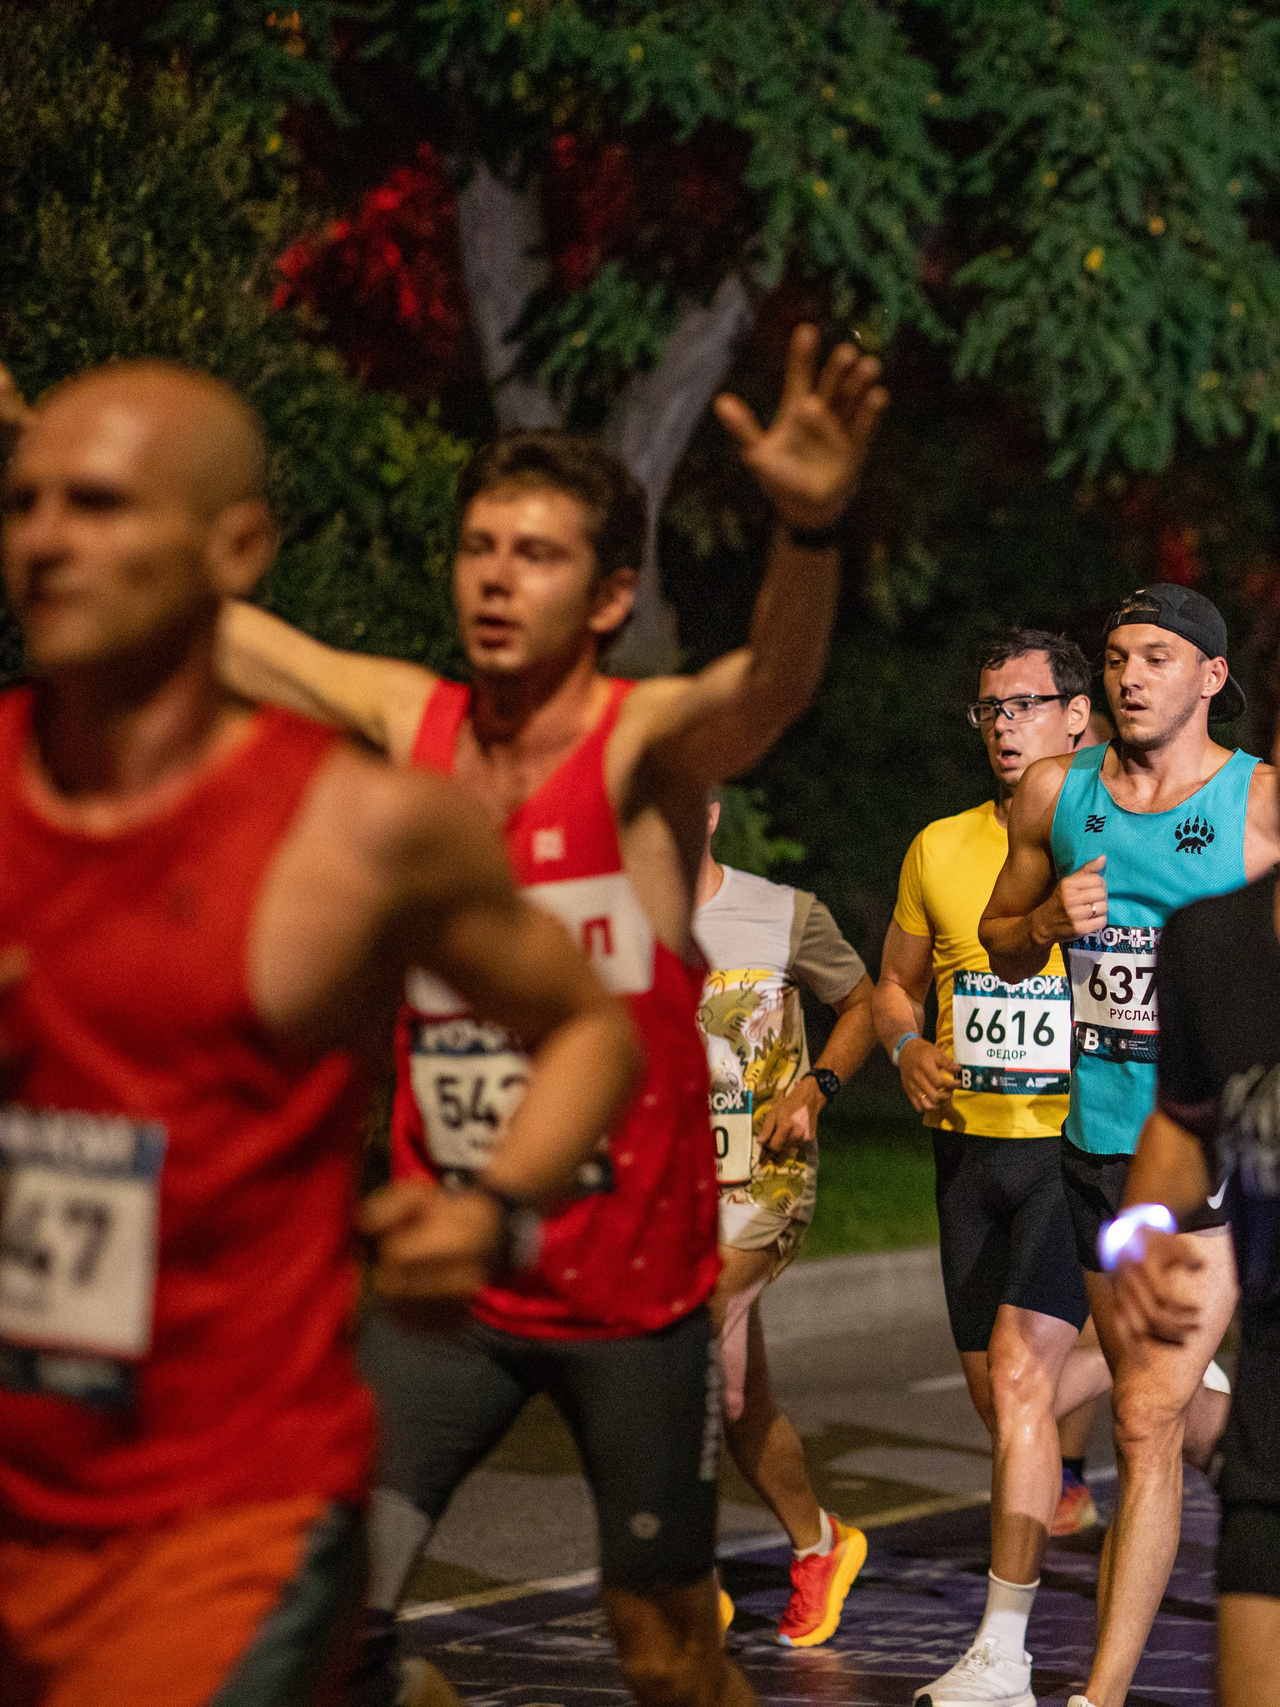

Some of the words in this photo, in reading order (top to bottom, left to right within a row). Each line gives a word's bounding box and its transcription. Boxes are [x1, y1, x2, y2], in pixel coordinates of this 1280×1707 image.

[965, 1008, 1055, 1047] 6616
[986, 1048, 1027, 1061] ФЕДОР
[435, 1073, 529, 1132] 54
